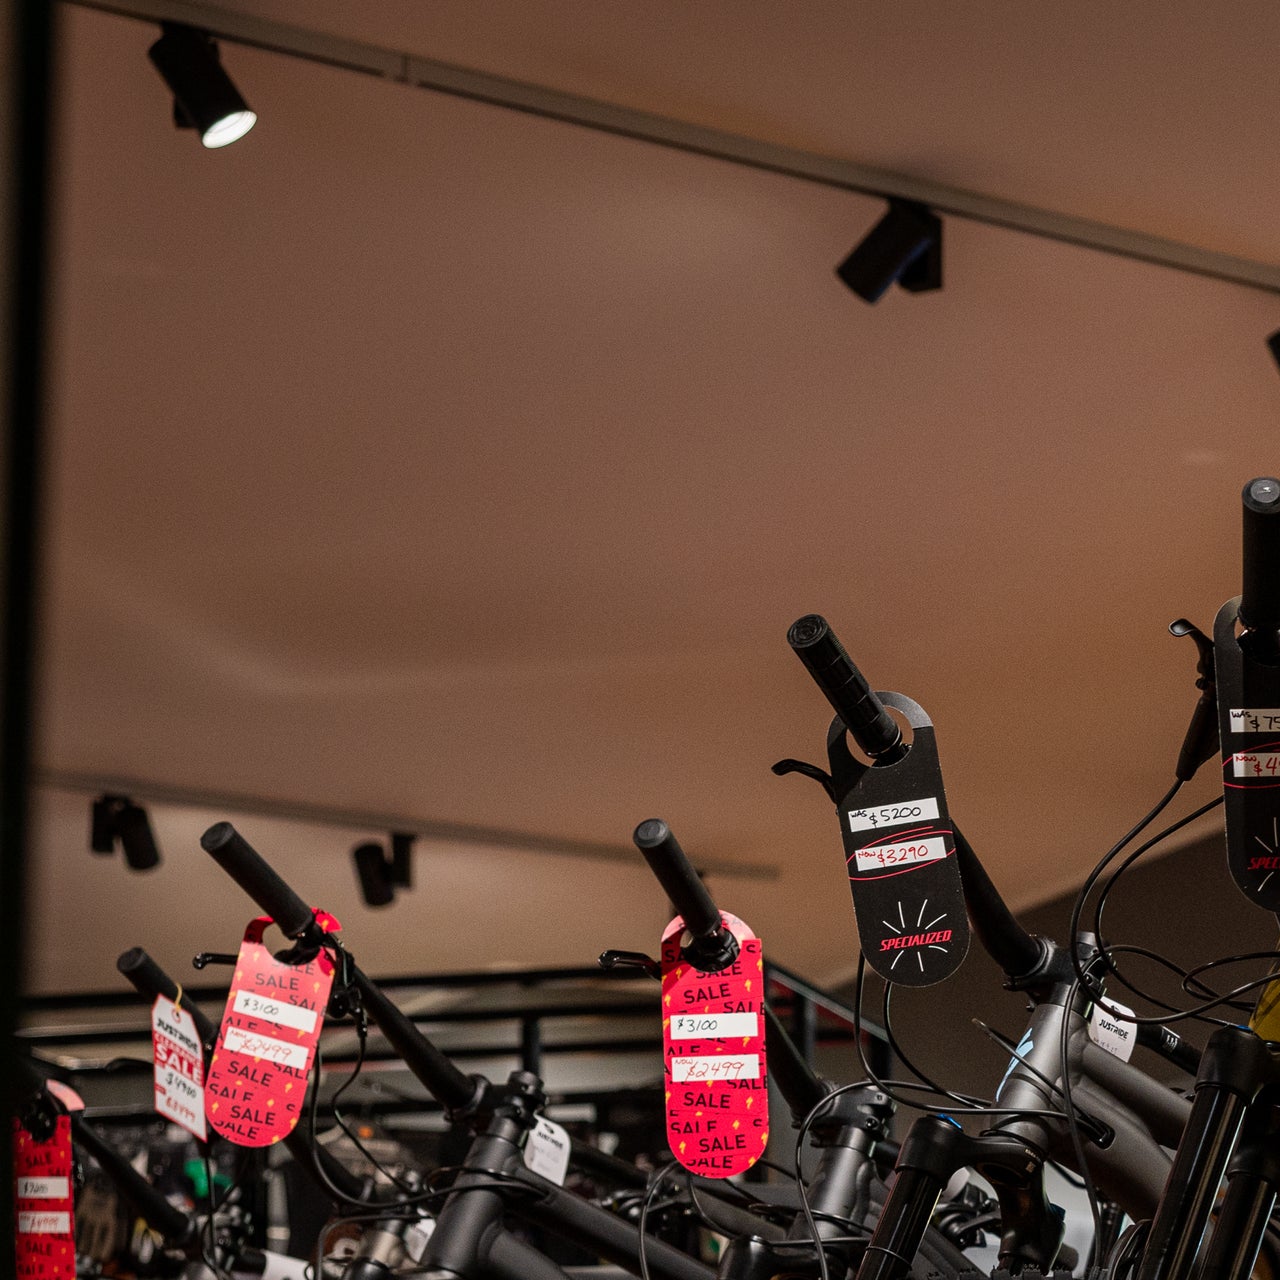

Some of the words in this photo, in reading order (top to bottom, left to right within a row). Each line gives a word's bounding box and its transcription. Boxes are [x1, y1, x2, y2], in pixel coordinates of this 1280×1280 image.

[851, 810, 867, 819] WAS
[869, 806, 921, 828] $5200
[858, 851, 876, 859] NOW
[877, 845, 929, 867] $3290
[879, 929, 953, 952] SPECIALIZED
[255, 973, 299, 991] SALE
[683, 983, 732, 1004] SALE
[242, 998, 279, 1016] $3100
[677, 1018, 718, 1032] $3100
[1098, 1018, 1129, 1040] JUSTRIDE
[155, 1043, 203, 1086] SALE
[228, 1061, 273, 1087] SALE
[675, 1058, 693, 1066] NOW
[686, 1061, 744, 1080] $2499
[683, 1093, 731, 1108] SALE
[231, 1105, 276, 1126] SALE
[699, 1134, 746, 1153] SALE
